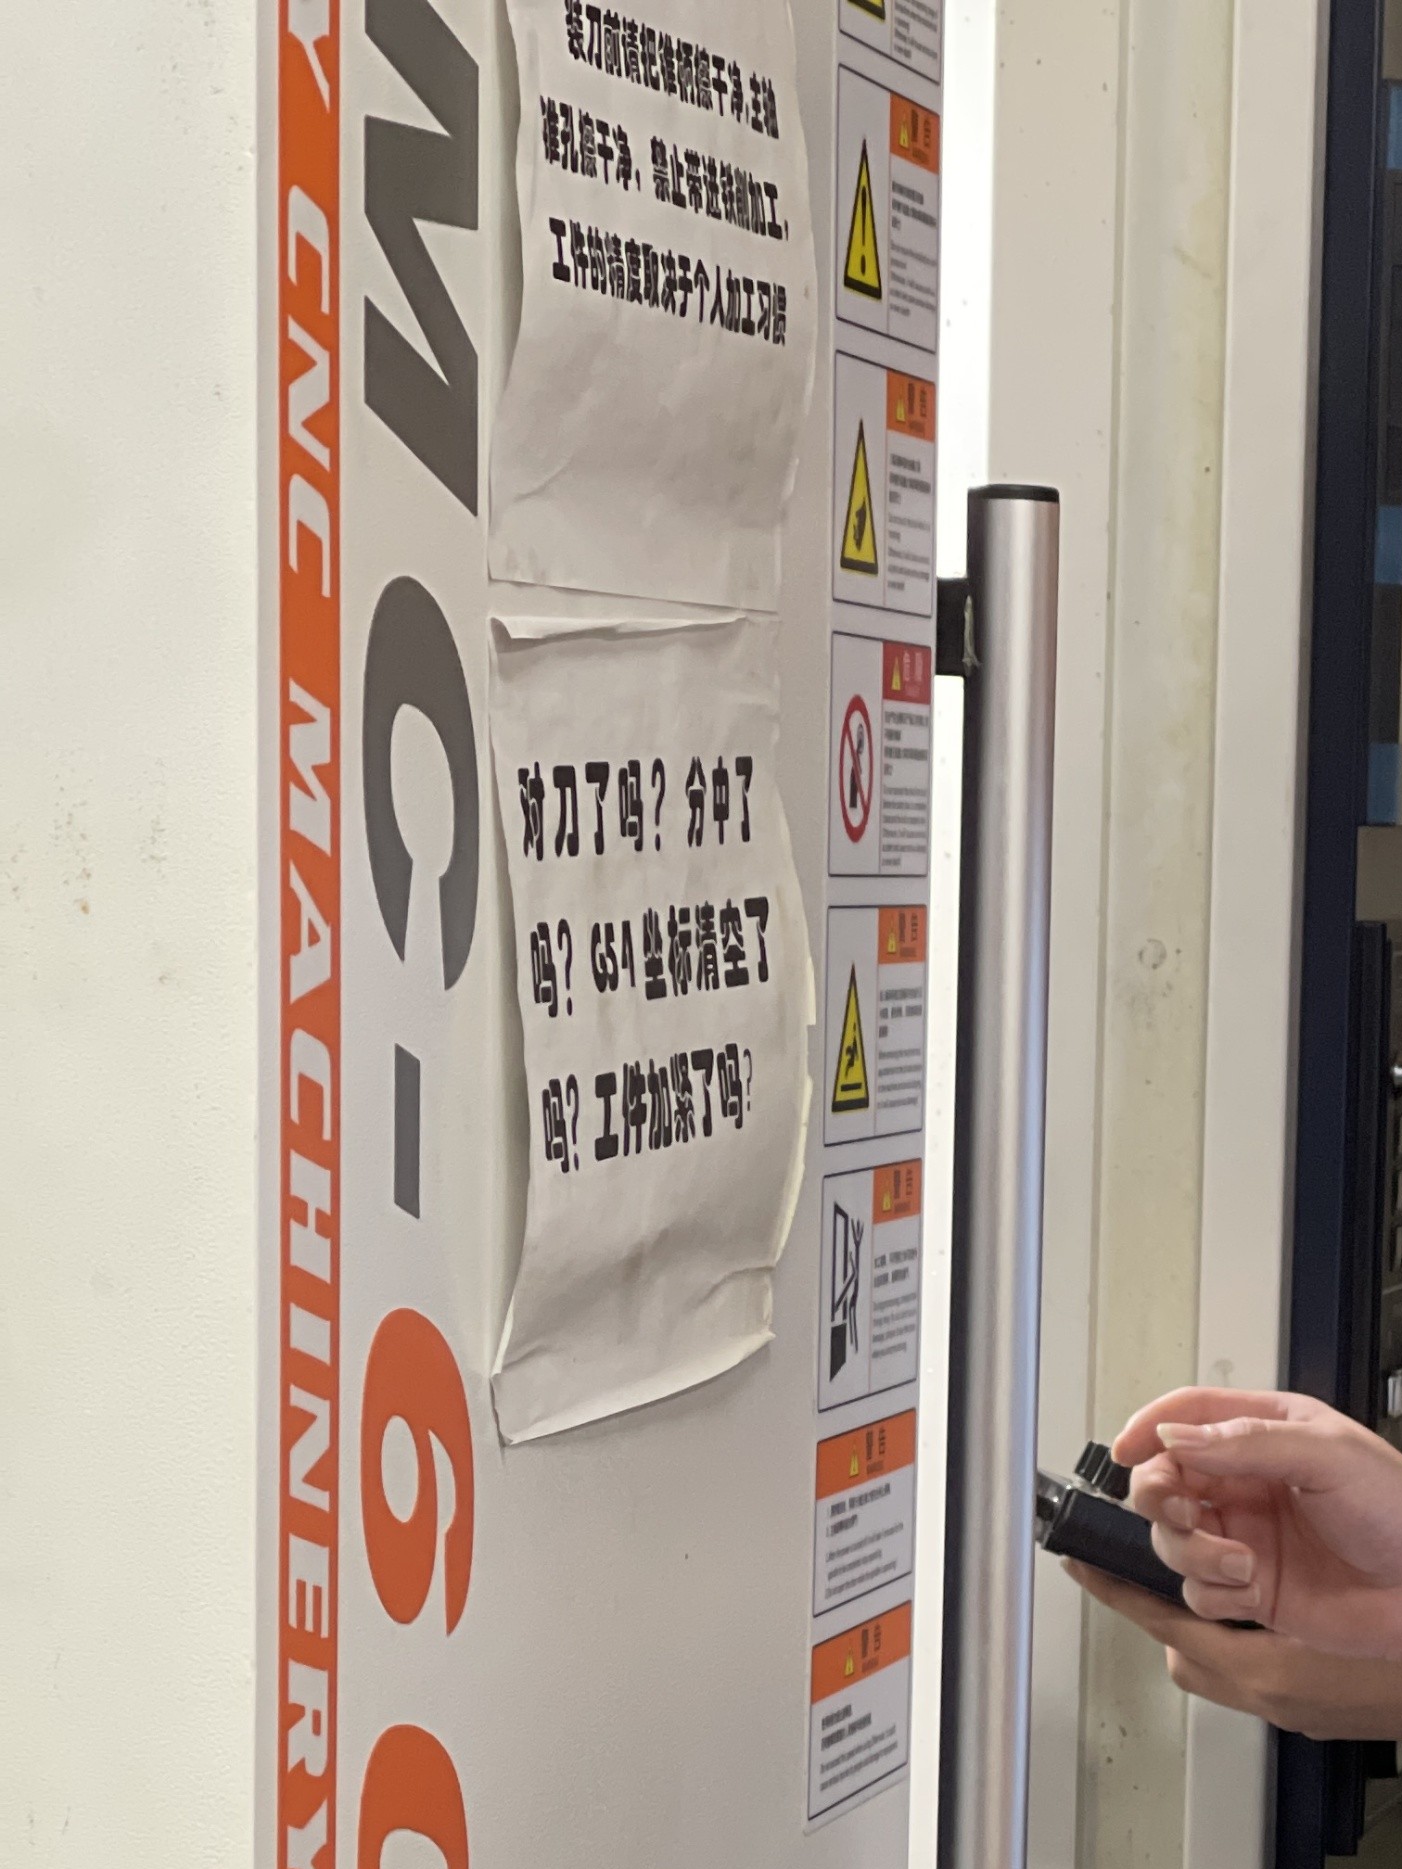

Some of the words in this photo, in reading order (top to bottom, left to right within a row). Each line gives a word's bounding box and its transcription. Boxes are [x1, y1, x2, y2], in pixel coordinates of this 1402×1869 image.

[288, 185, 330, 597] CNC
[548, 217, 787, 346] 工件的精度取决于个人加工习惯
